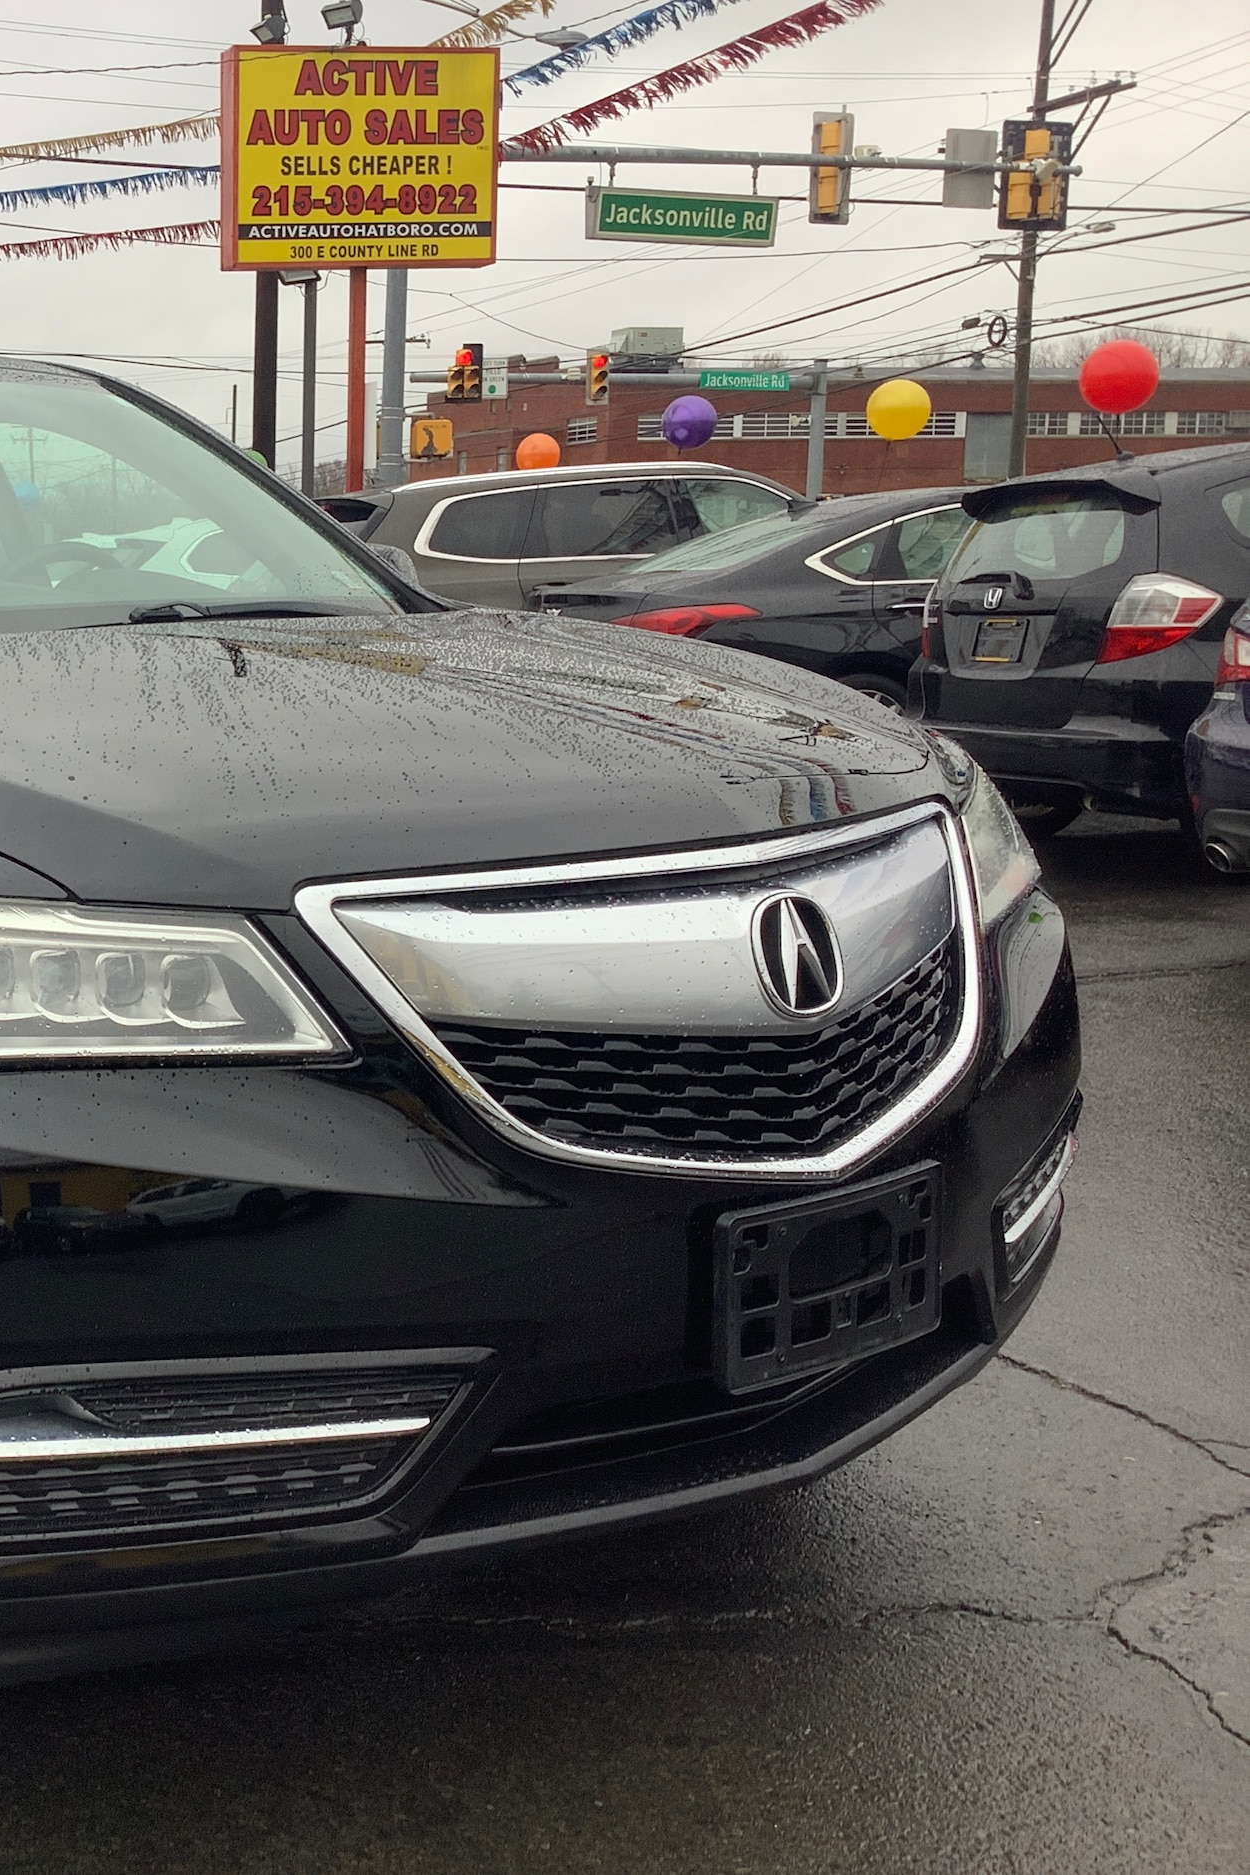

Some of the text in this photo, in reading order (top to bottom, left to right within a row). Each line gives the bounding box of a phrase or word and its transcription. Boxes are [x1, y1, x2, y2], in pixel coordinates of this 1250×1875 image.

[294, 59, 439, 96] ACTIVE
[246, 109, 485, 146] AUTO SALES
[280, 155, 341, 176] SELLS
[348, 154, 440, 175] CHEAPER
[251, 184, 478, 217] 215-394-8922
[605, 203, 768, 231] Jacksonville Rd
[248, 222, 478, 239] ACTIVEAUTOHATBORO.COM
[290, 244, 440, 259] 300 E COUNTY LINE RD
[705, 373, 785, 388] Jacksonville Rd
